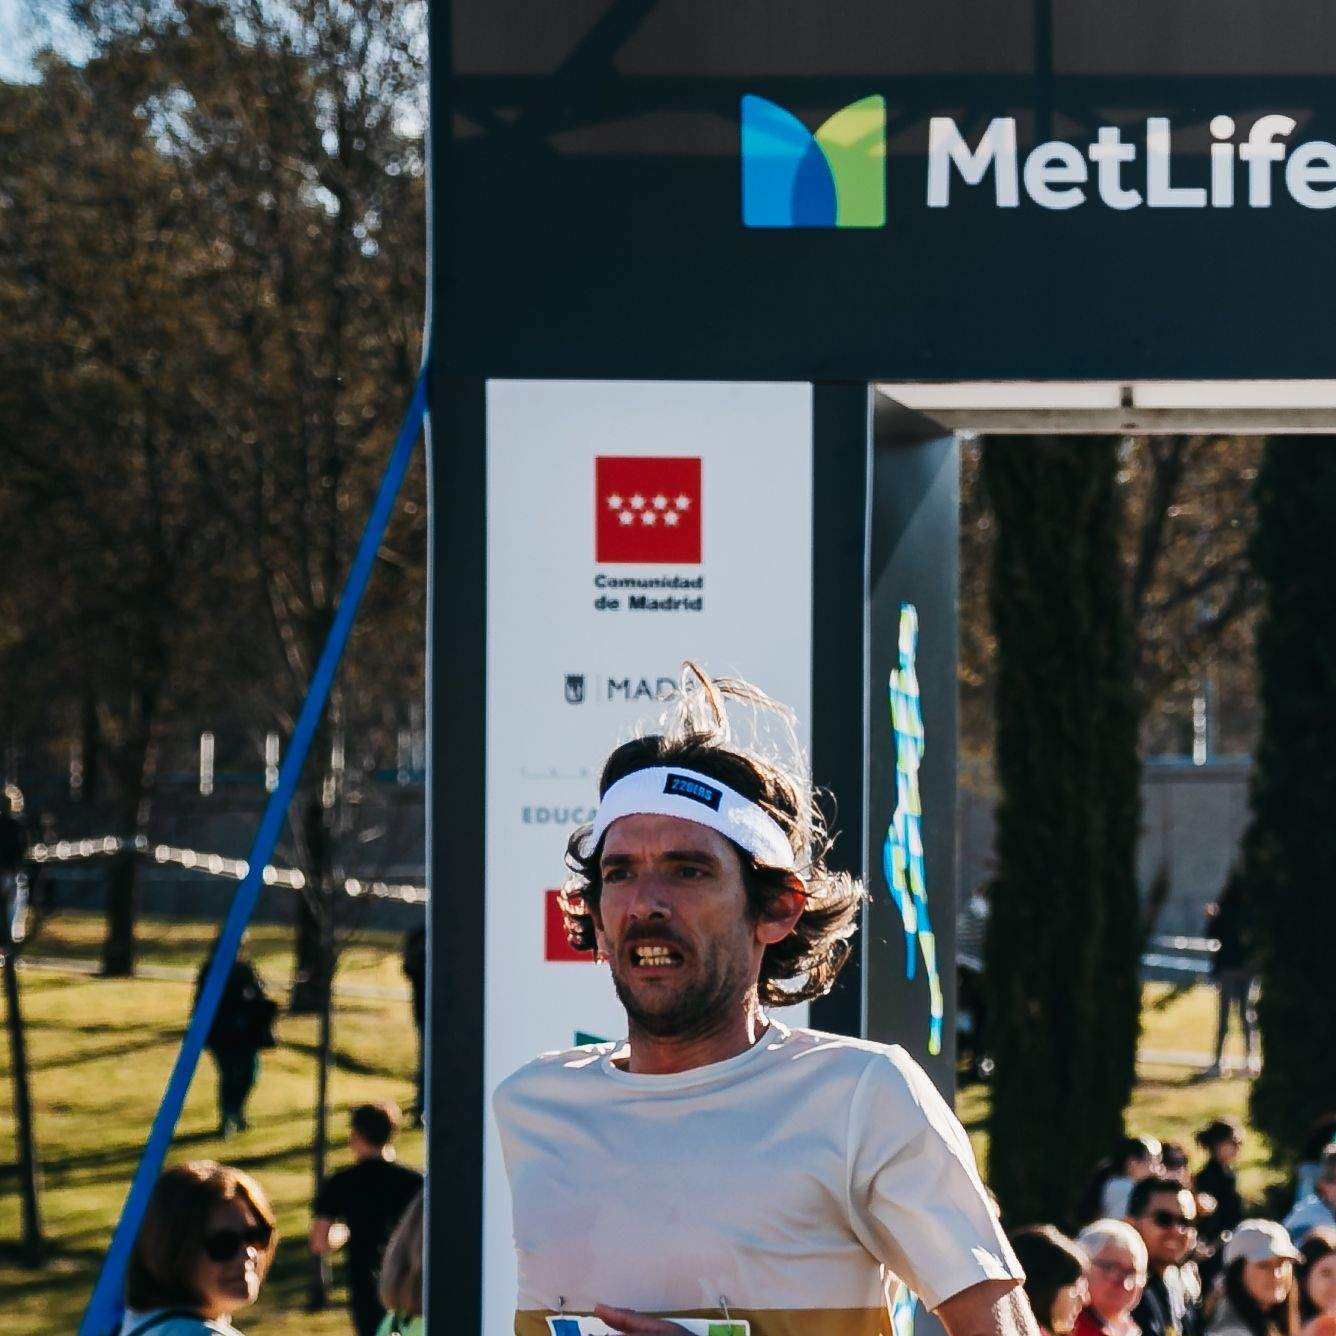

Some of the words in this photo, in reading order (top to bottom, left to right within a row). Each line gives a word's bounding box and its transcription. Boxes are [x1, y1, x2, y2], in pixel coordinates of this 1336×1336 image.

[594, 575, 703, 589] Comunidad
[594, 596, 620, 610] de
[628, 595, 703, 610] Madrid
[607, 676, 698, 701] MAD
[521, 806, 599, 824] EDUCA
